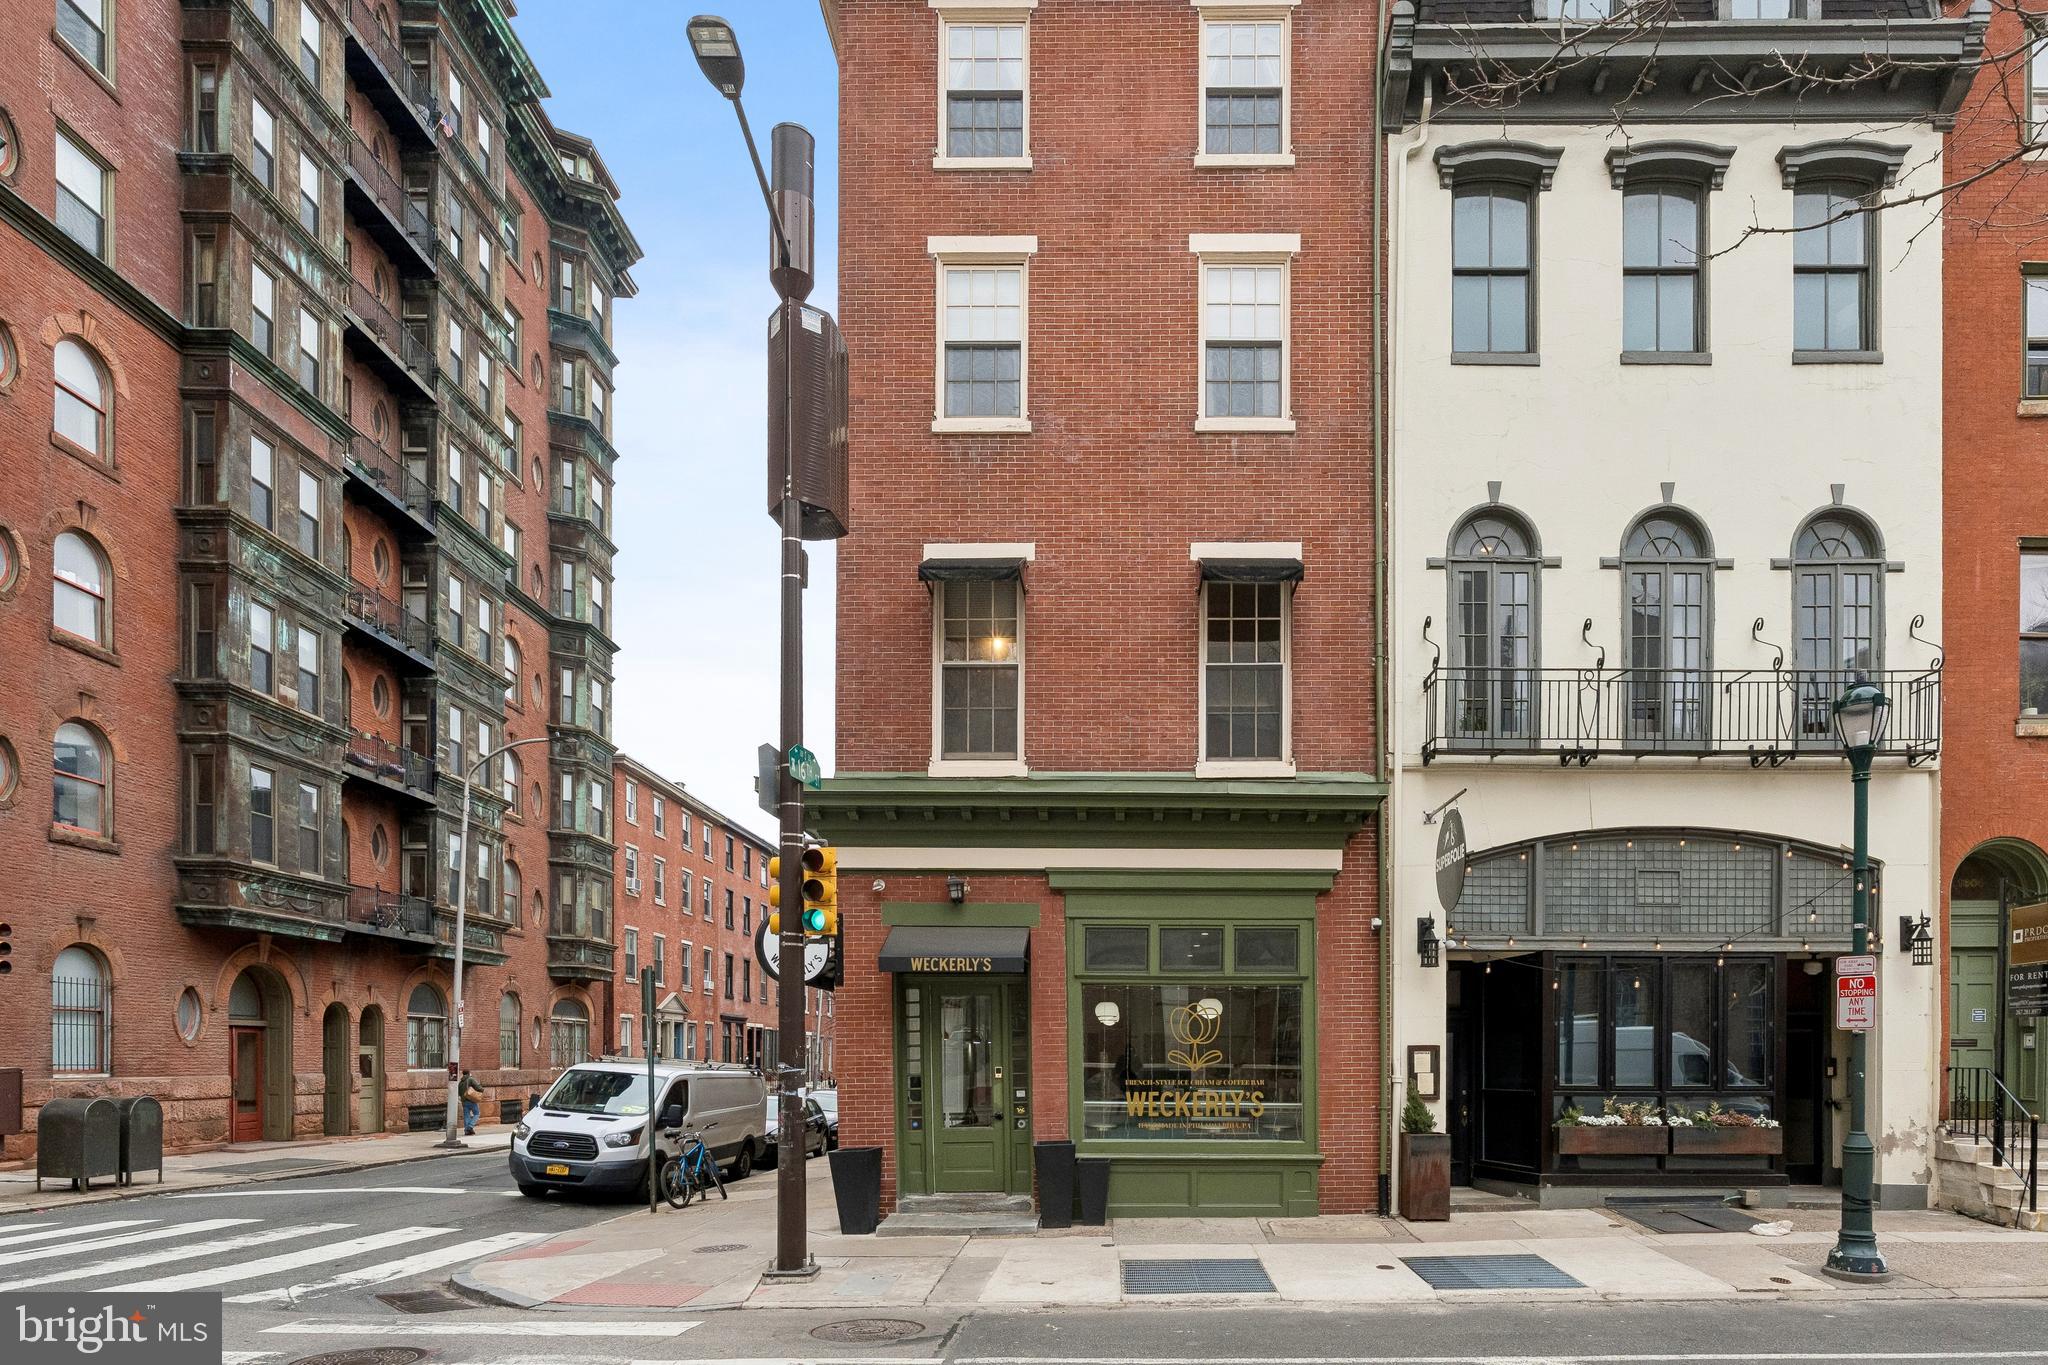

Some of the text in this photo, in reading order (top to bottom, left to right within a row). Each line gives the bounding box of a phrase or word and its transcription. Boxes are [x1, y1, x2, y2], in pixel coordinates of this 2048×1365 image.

[1436, 842, 1465, 872] SUPERFOLIE
[911, 957, 992, 971] WECKERLY'S
[2027, 970, 2048, 980] RENT
[1849, 978, 1865, 989] NO
[1840, 989, 1874, 997] STOPPING
[1848, 998, 1864, 1006] ANY
[1848, 1007, 1865, 1015] TIME
[1126, 1091, 1265, 1118] WECKERLY'S
